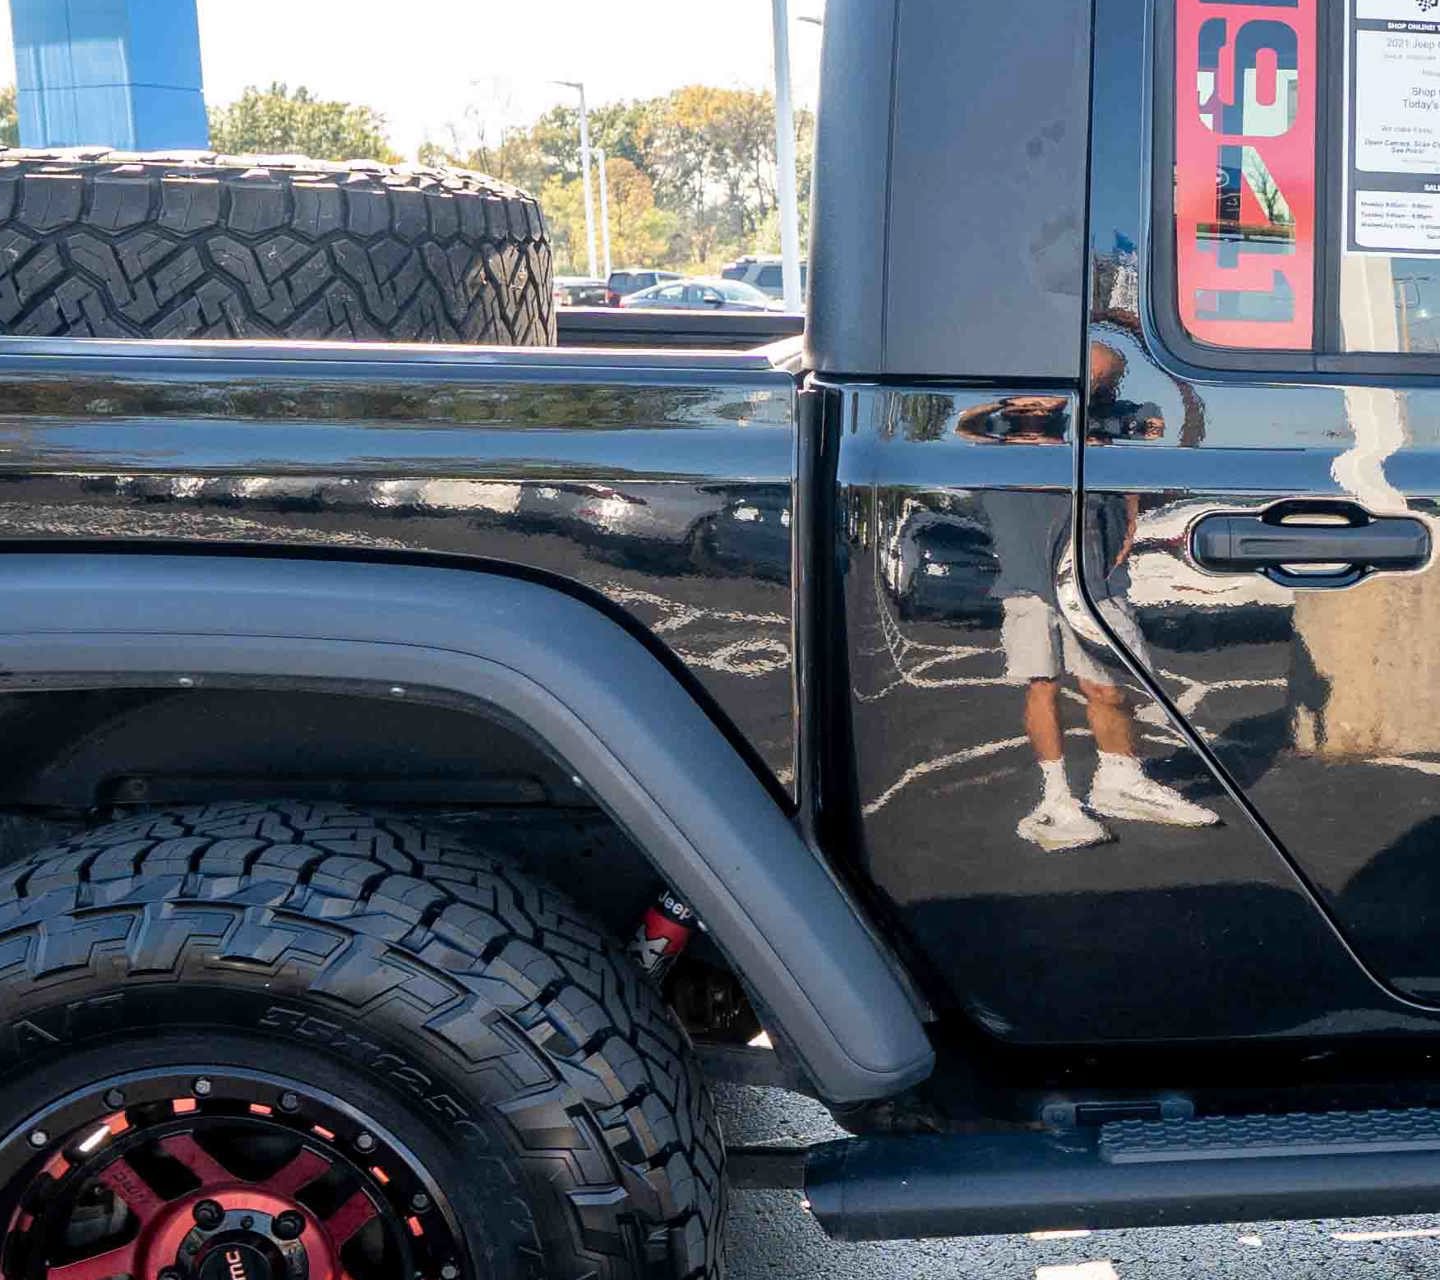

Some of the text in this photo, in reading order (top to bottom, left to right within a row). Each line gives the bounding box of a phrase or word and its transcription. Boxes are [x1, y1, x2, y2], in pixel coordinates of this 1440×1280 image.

[1388, 22, 1407, 30] SHOP
[1387, 38, 1408, 48] 2021
[1412, 39, 1435, 51] Jeep
[1412, 87, 1436, 99] Shop
[658, 890, 695, 920] Jeep
